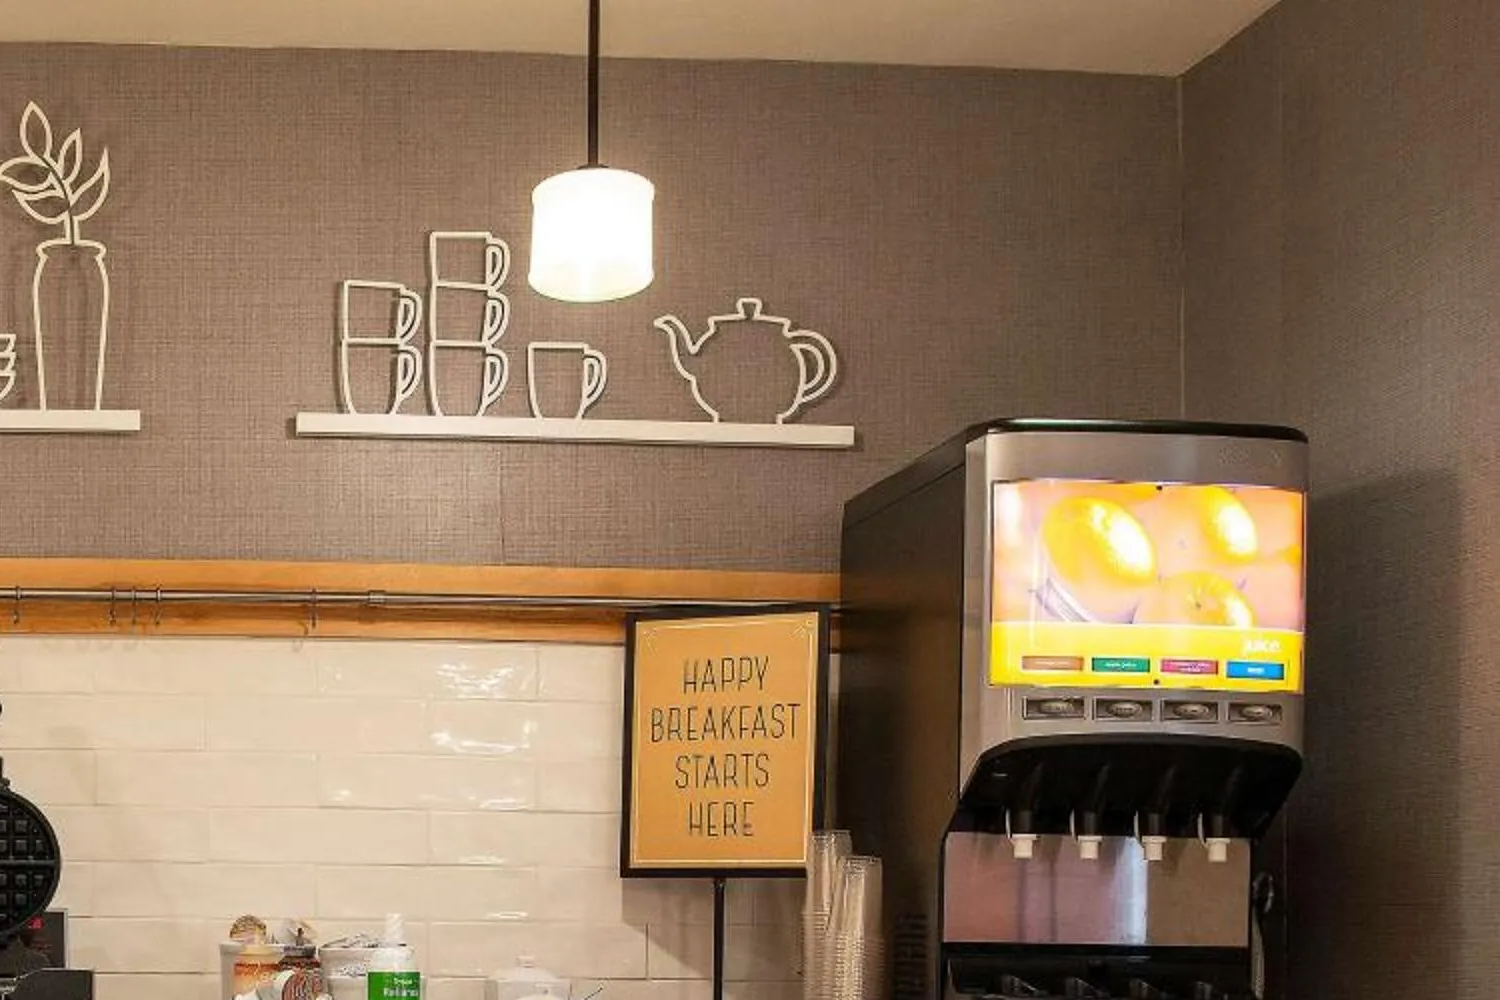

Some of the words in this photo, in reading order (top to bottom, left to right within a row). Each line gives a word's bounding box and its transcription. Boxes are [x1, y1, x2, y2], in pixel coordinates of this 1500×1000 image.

[683, 656, 770, 694] HAPPY
[651, 703, 801, 743] BREAKFAST
[675, 752, 771, 790] STARTS
[689, 801, 756, 838] HERE
